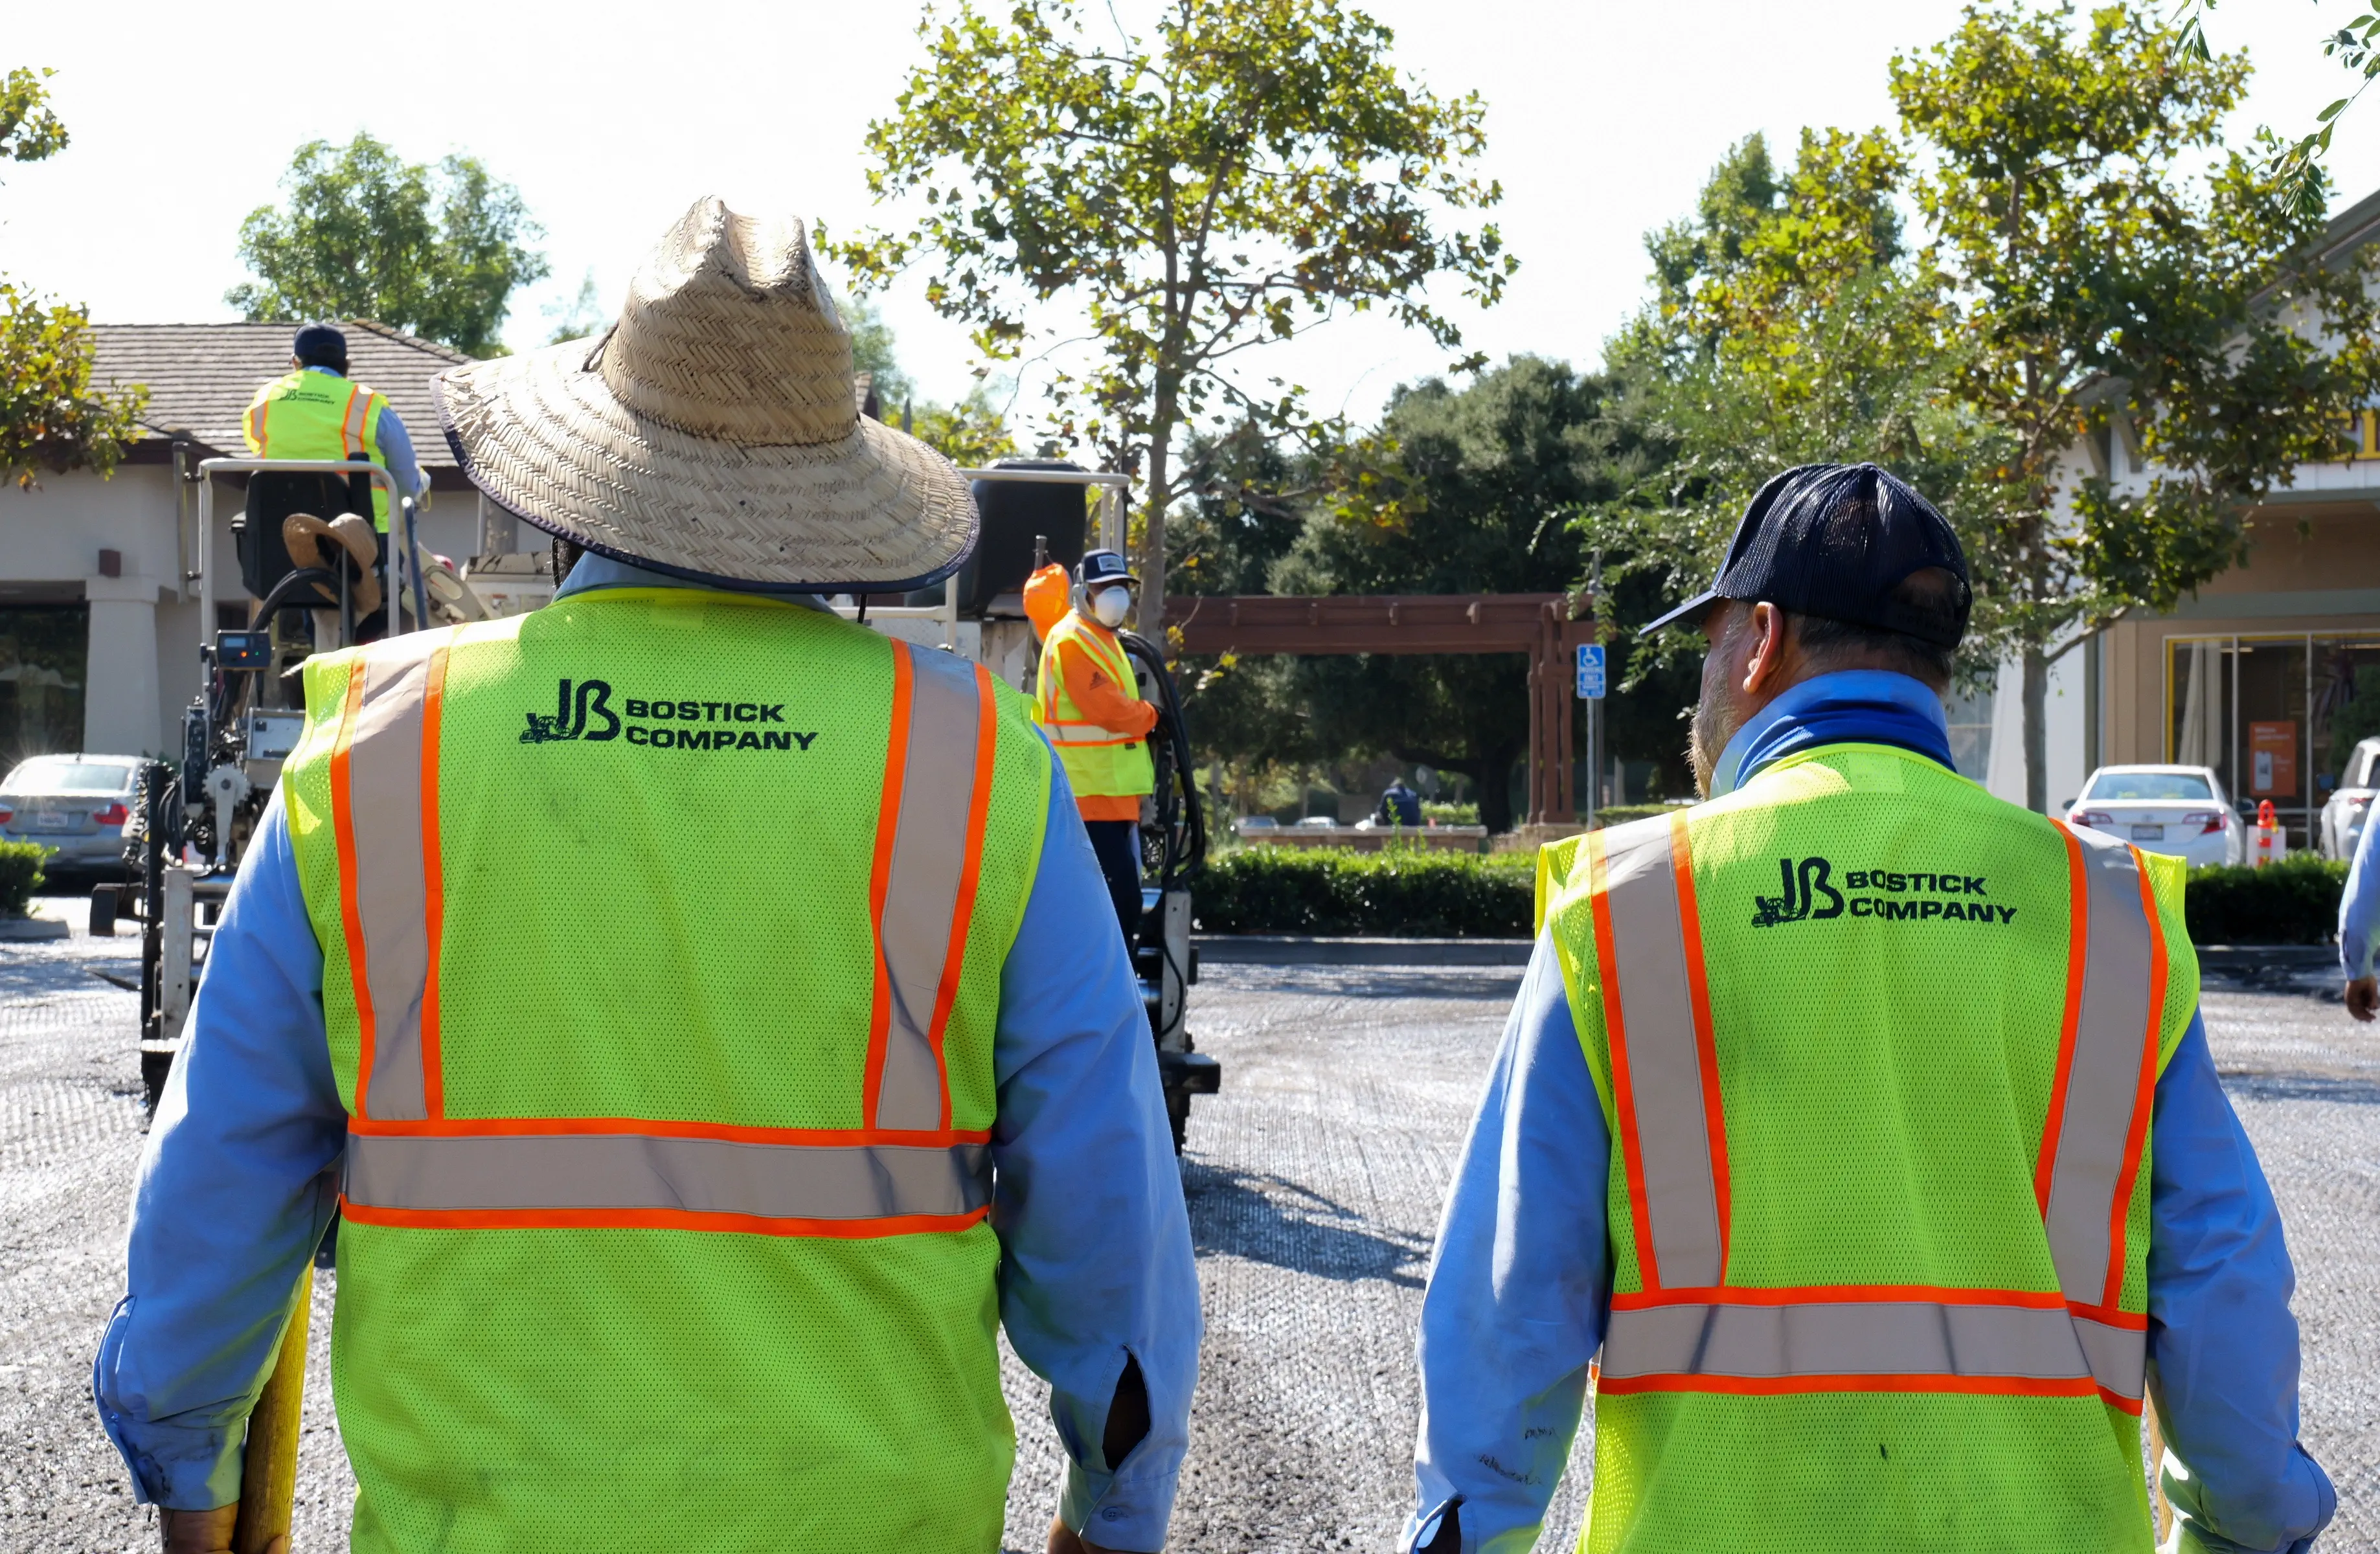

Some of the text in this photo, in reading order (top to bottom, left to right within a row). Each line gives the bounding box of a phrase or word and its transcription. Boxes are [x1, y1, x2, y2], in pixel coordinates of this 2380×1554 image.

[522, 679, 621, 743] JB
[626, 699, 786, 723] BOSTICK
[626, 726, 818, 750] COMPANY
[1753, 857, 1844, 922] JB
[1846, 870, 1987, 895] BOSTICK
[1850, 898, 2017, 924] COMPANY
